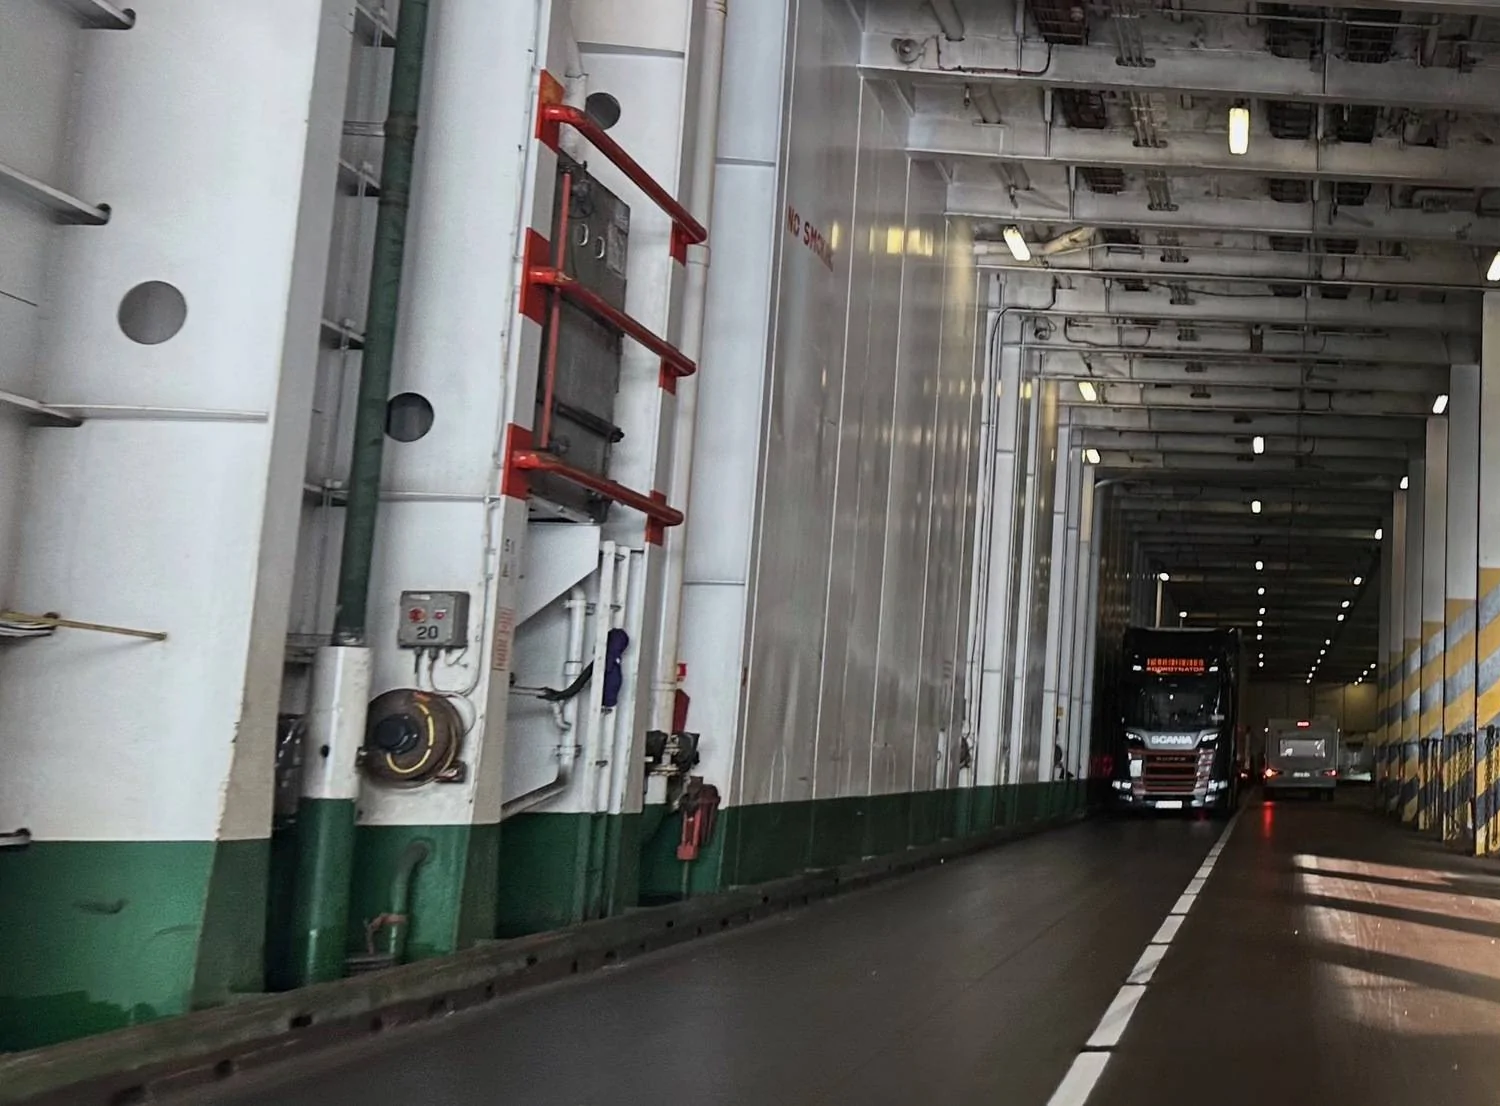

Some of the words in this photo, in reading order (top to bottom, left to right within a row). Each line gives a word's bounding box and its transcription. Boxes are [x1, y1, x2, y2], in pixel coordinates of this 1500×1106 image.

[787, 204, 800, 237] NO
[803, 221, 835, 273] SMOK
[416, 625, 438, 639] 20
[1151, 735, 1192, 744] SCANIA
